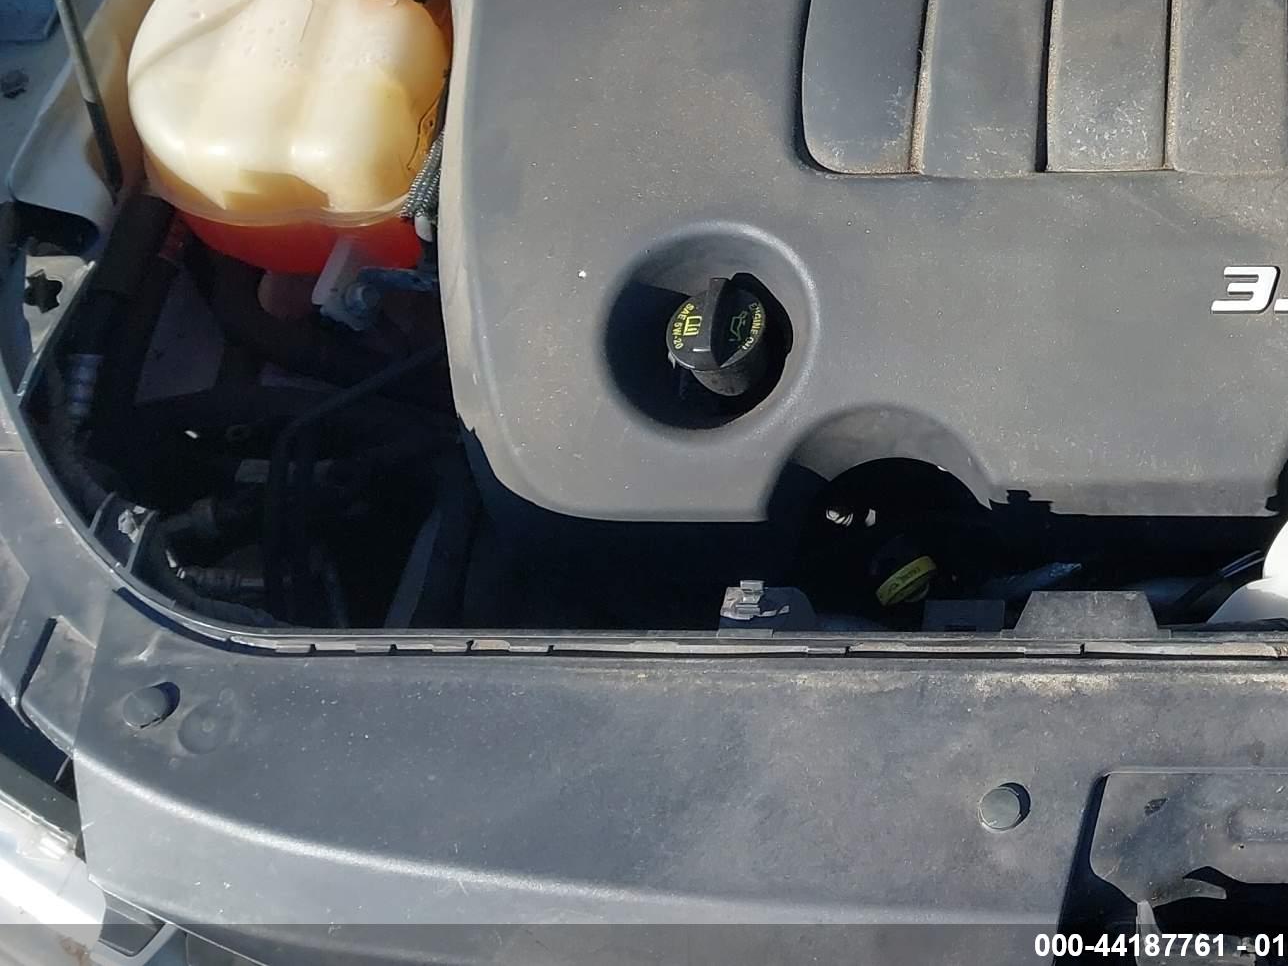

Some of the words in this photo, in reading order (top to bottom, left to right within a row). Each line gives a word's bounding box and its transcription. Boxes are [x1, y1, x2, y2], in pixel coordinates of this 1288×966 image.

[677, 303, 695, 321] SAE
[749, 302, 762, 335] ENGINE
[672, 322, 684, 350] 5W-20
